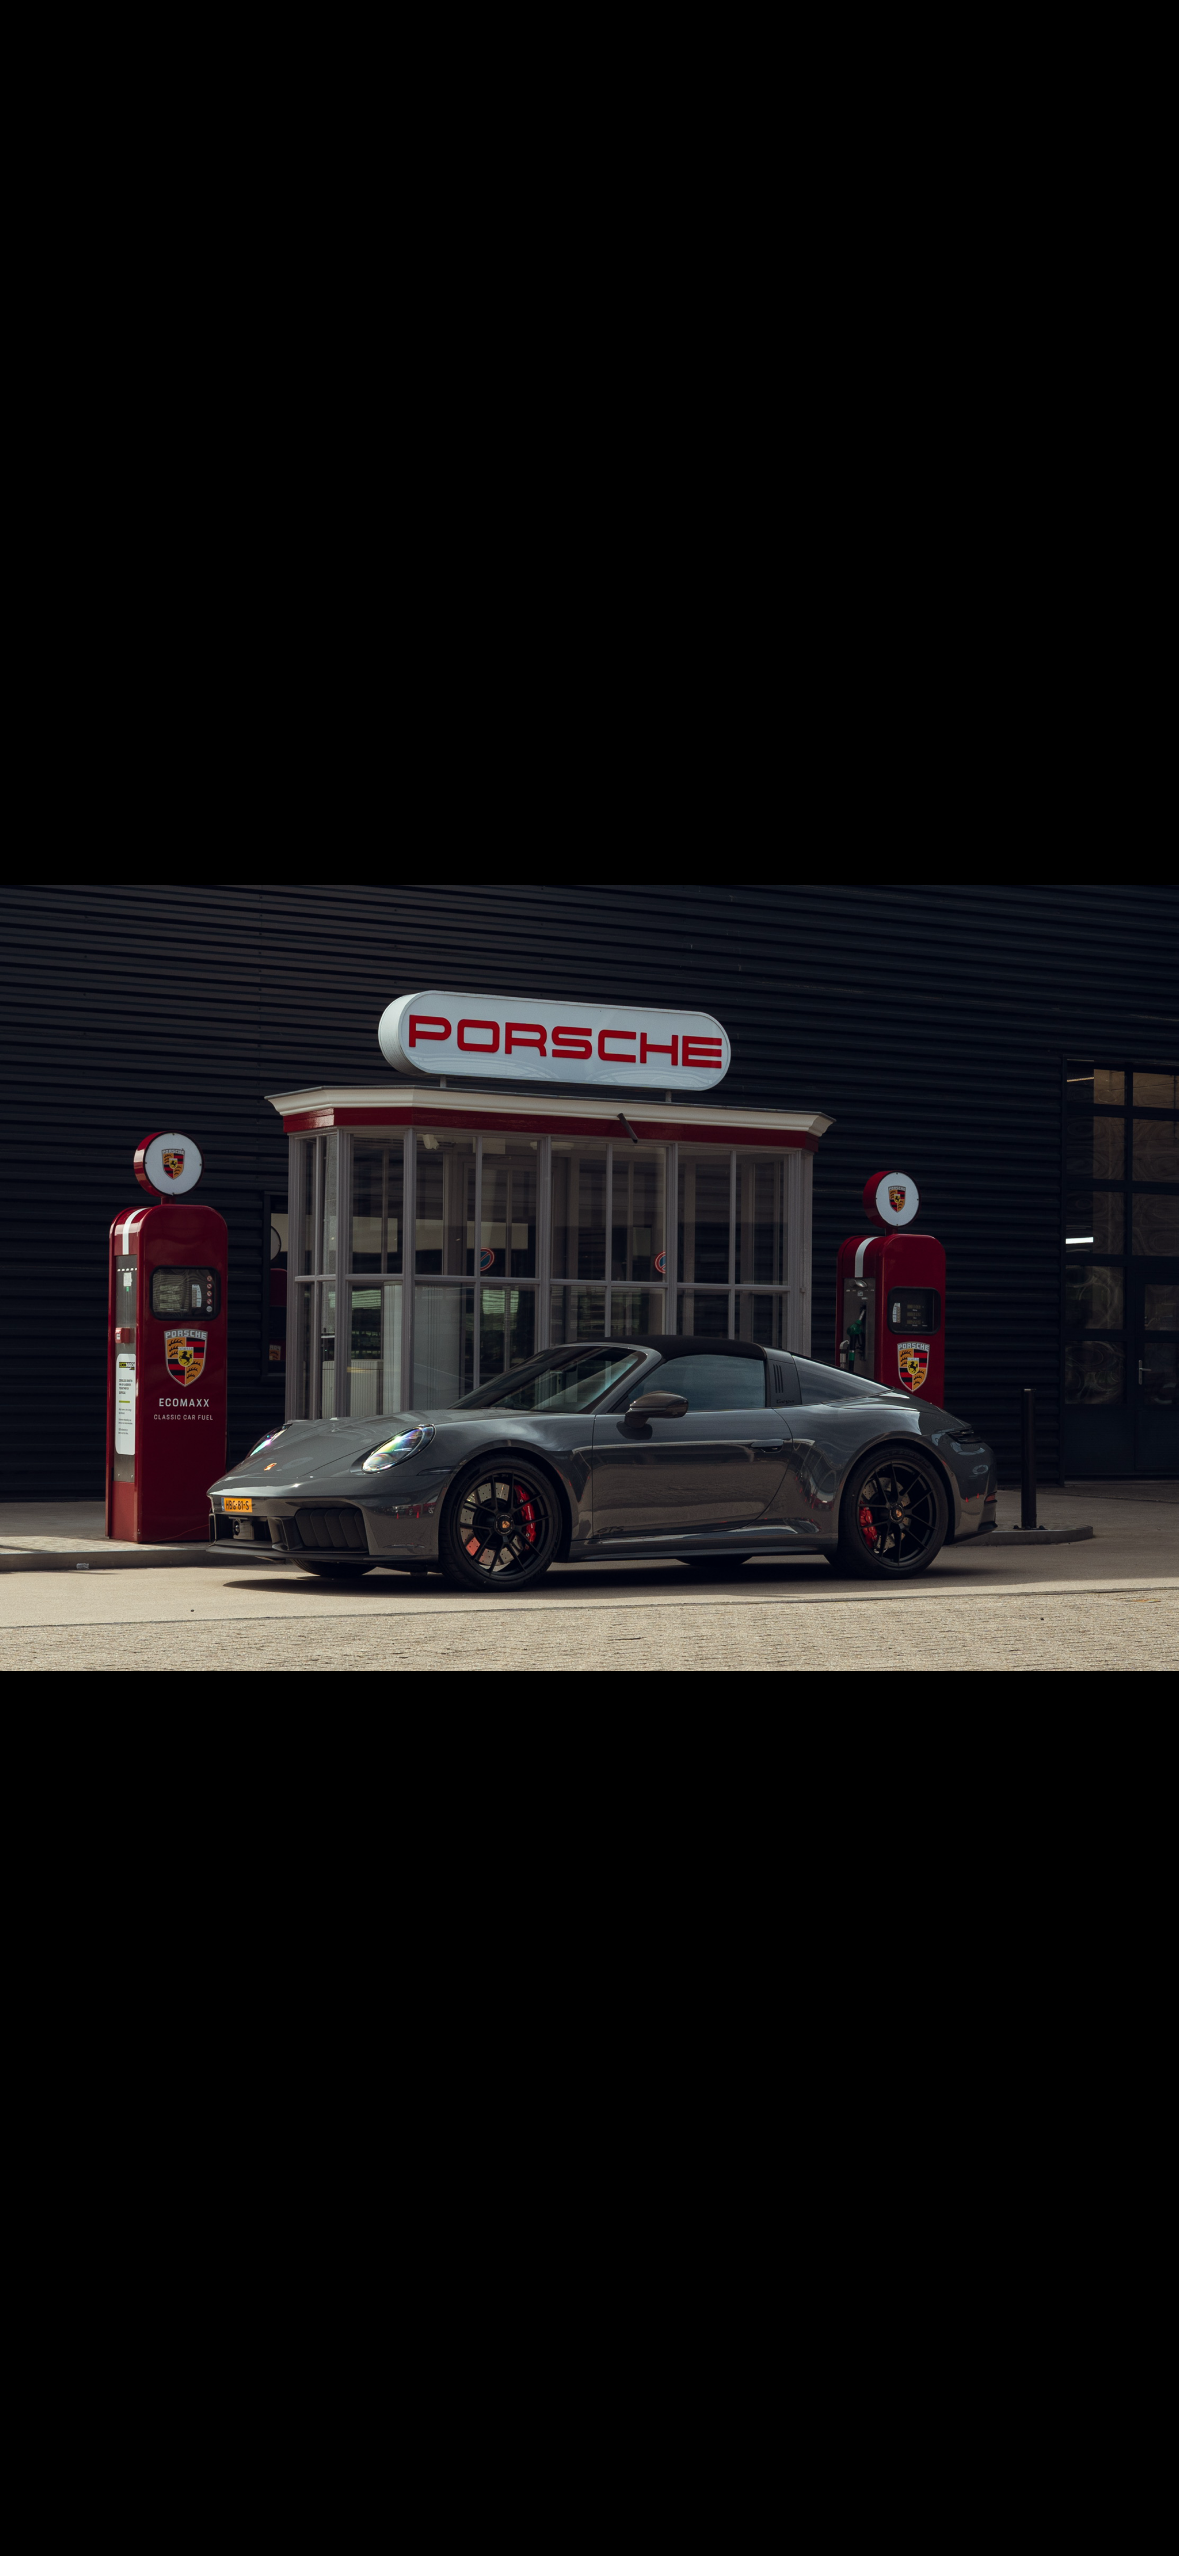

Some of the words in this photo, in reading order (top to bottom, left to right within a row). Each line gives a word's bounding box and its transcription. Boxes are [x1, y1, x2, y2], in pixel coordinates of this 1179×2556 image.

[408, 1014, 722, 1069] PORSCHE
[165, 1330, 208, 1340] PORSCHE
[898, 1342, 930, 1351] PORSCHE
[158, 1398, 210, 1407] ECOMAXX
